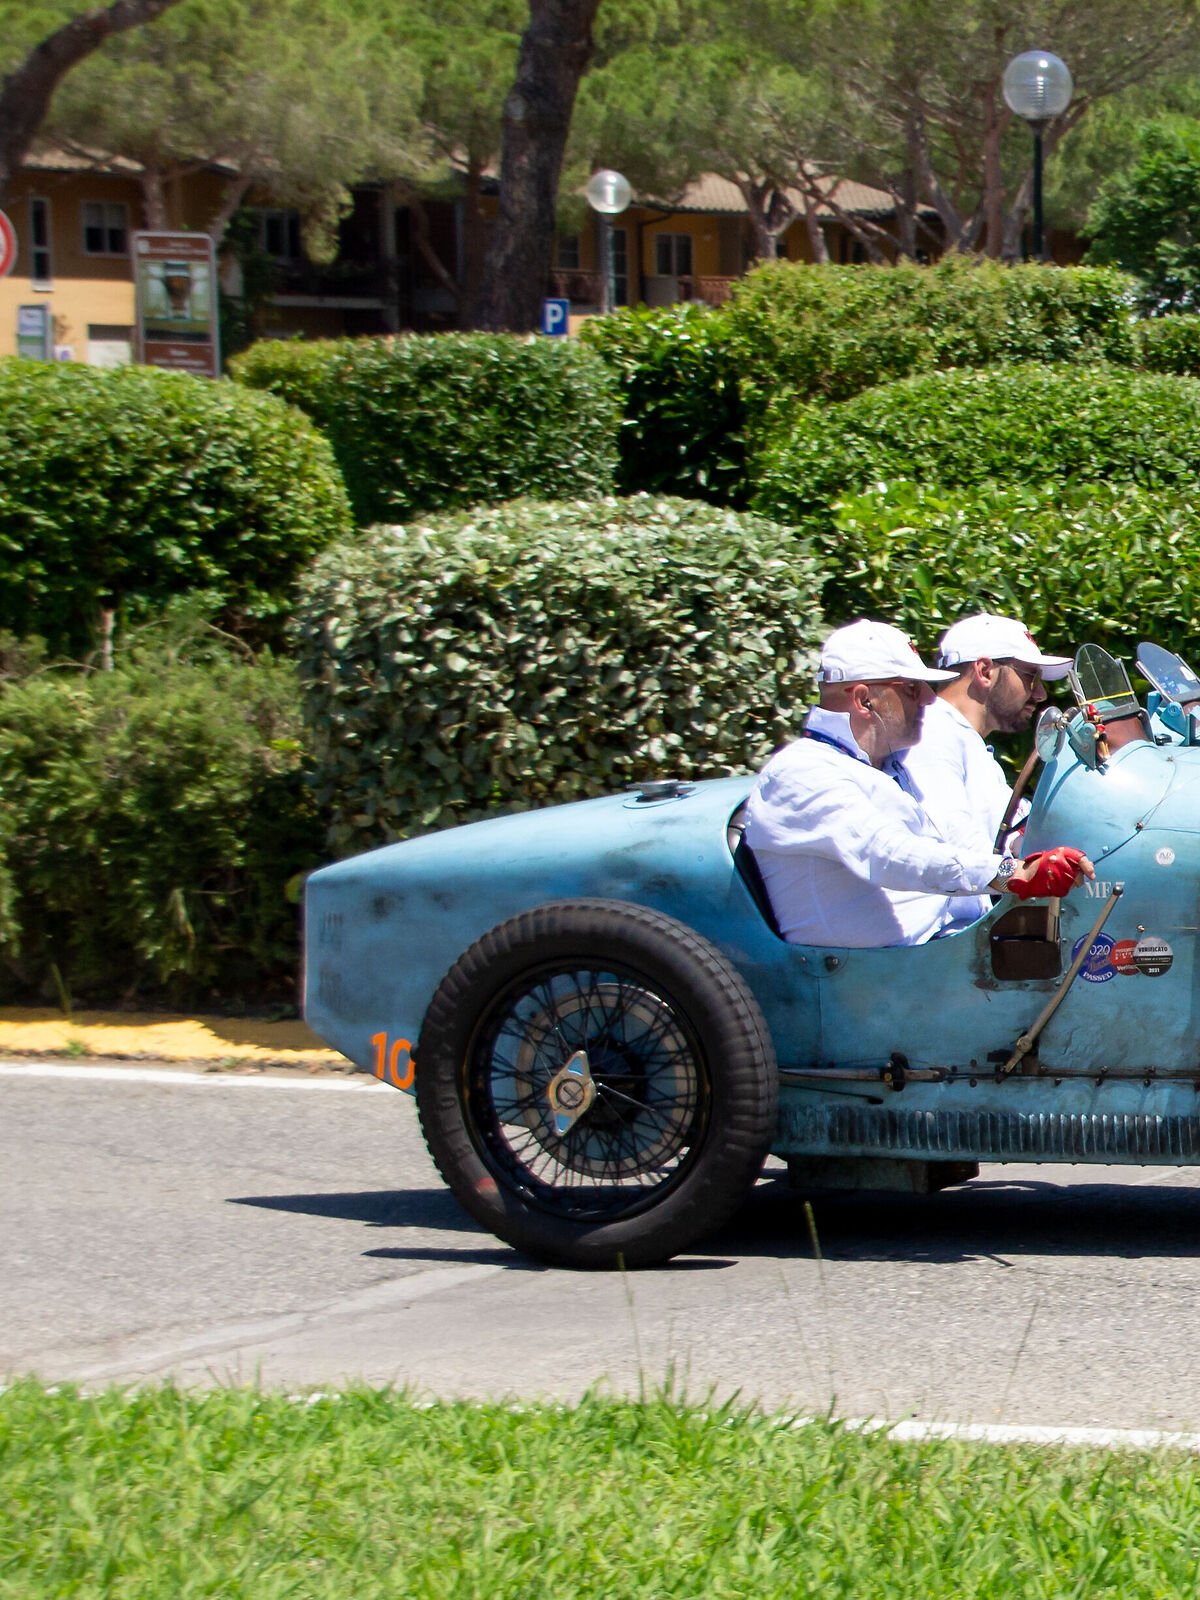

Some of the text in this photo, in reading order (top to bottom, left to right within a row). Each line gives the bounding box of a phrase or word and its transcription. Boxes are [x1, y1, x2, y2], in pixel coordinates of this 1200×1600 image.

[546, 303, 563, 333] P
[1084, 882, 1111, 898] MF
[1088, 944, 1111, 956] 020
[1082, 971, 1113, 982] PASSED
[372, 1031, 416, 1090] 10
